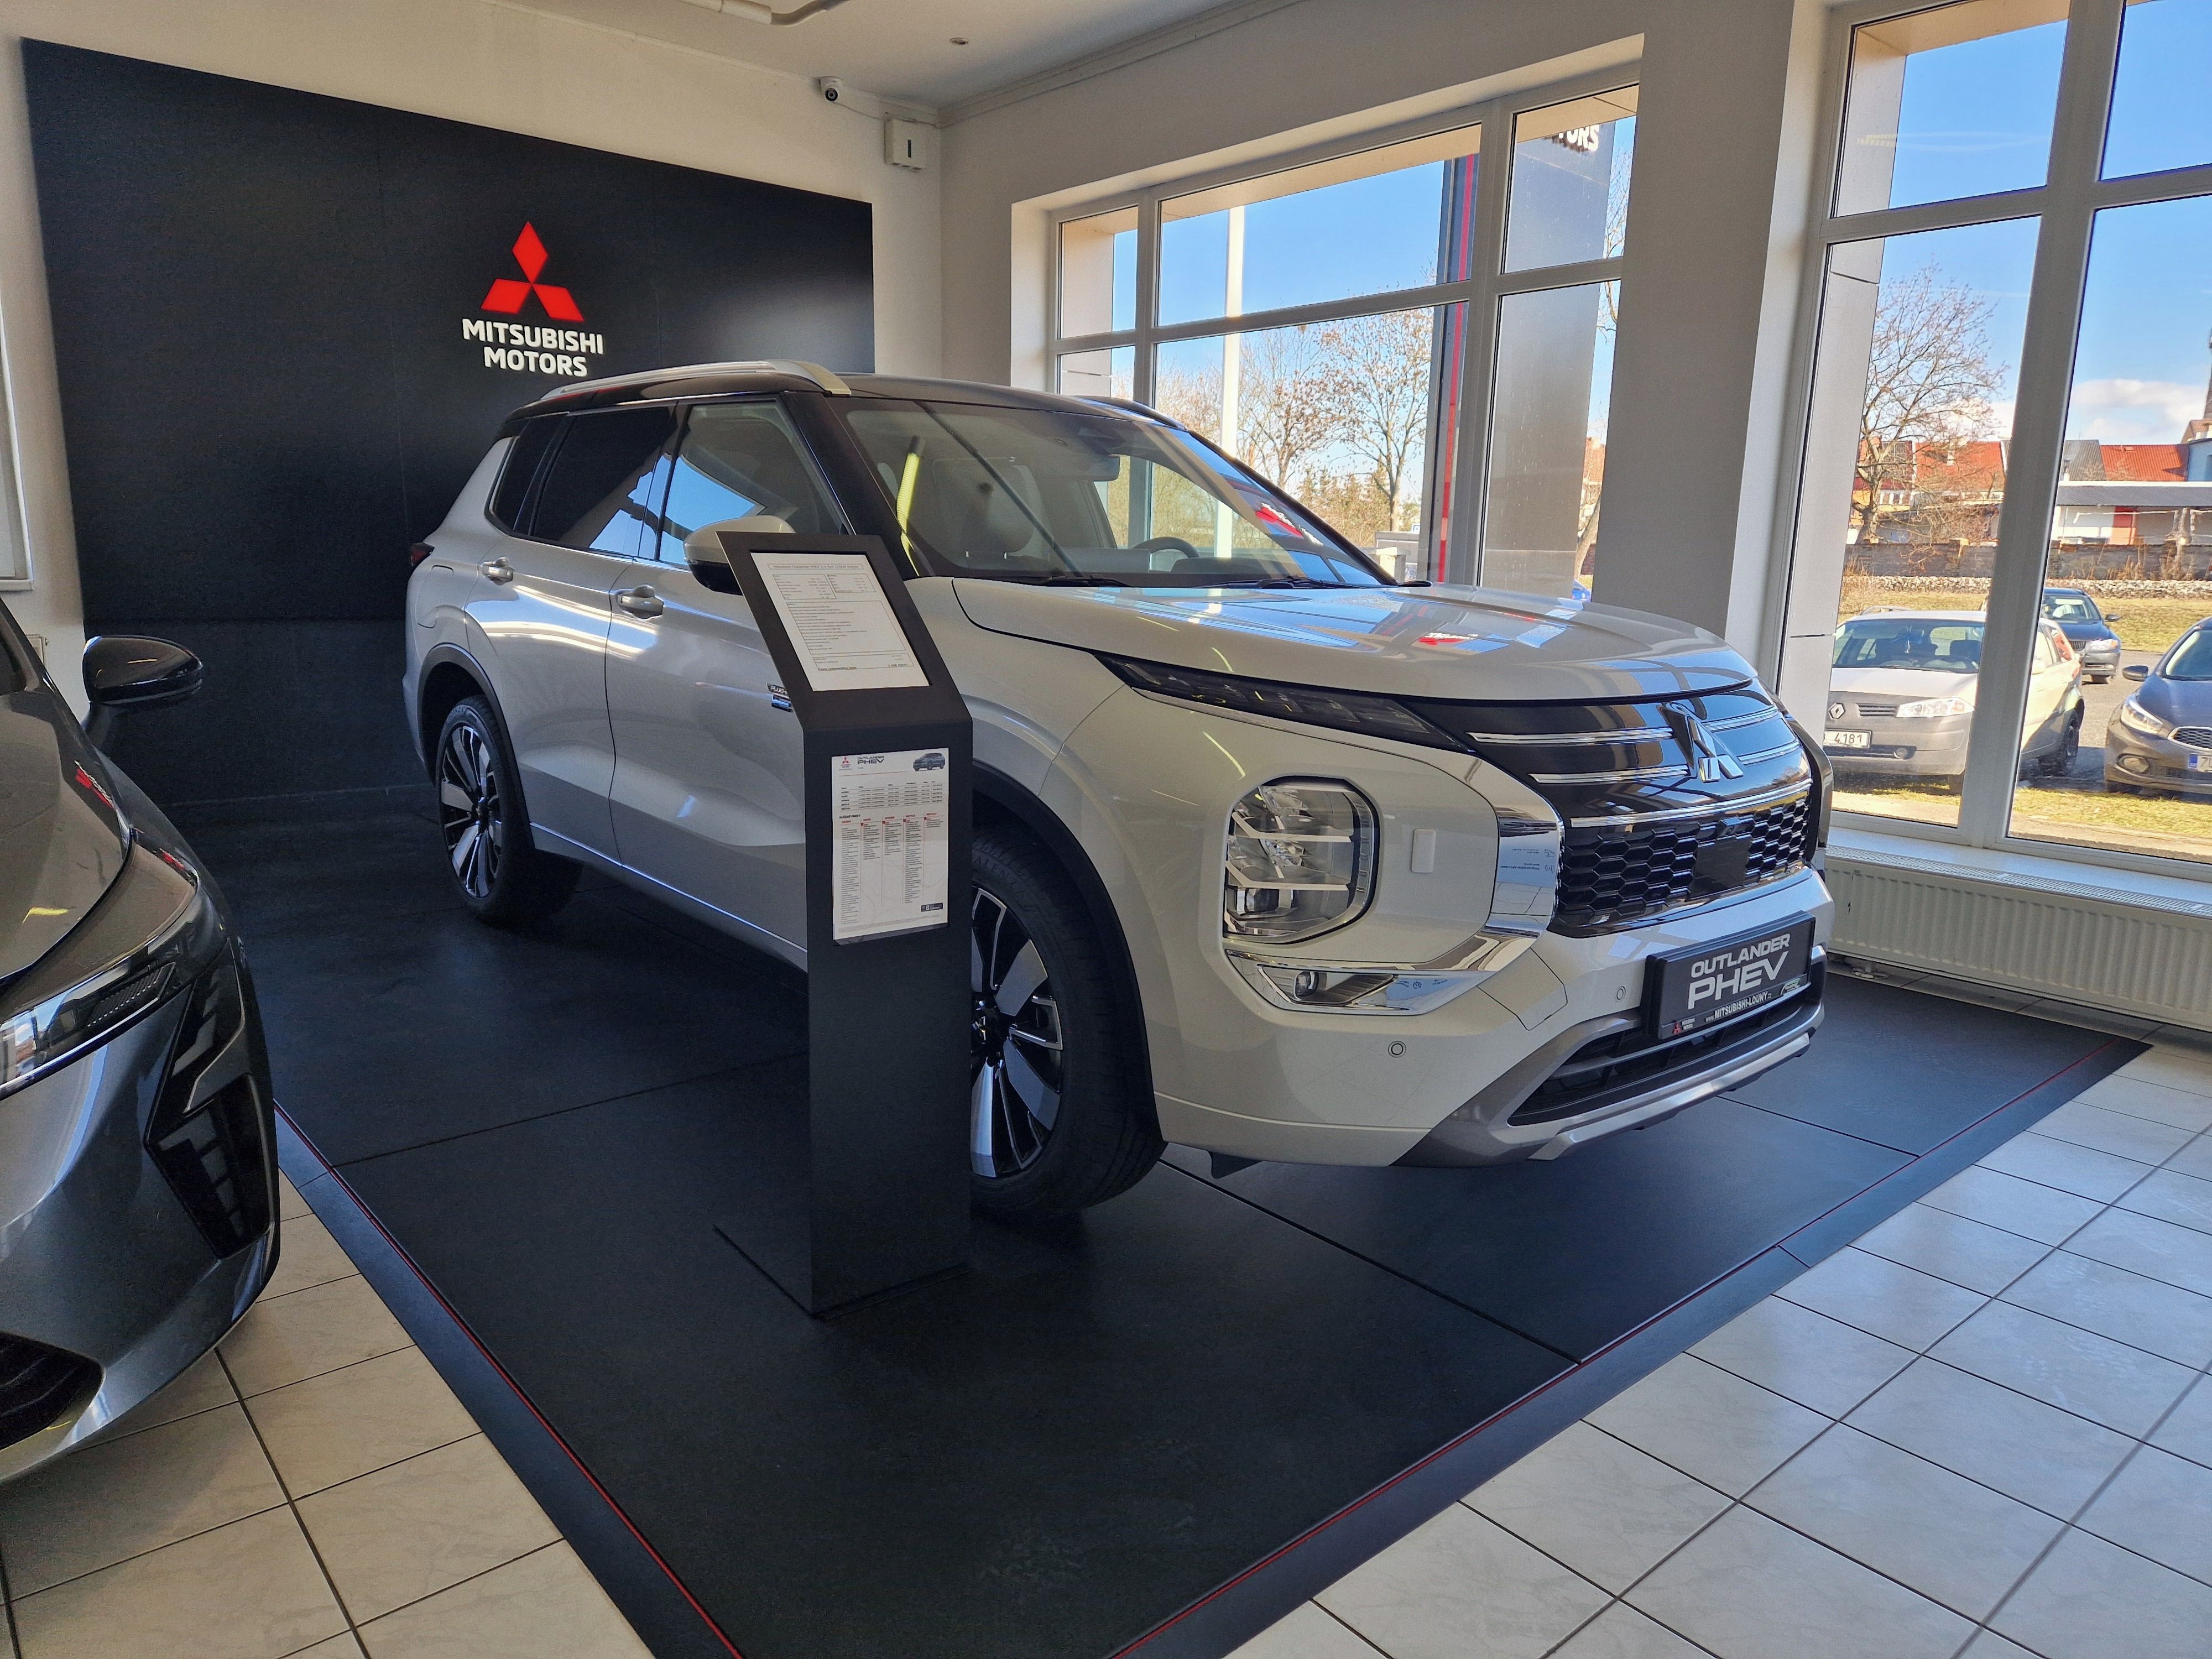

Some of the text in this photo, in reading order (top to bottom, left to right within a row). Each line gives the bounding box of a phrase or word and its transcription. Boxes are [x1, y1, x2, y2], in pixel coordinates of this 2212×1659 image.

[462, 318, 604, 354] MITSUBISHI
[483, 346, 588, 377] MOTORS
[1834, 733, 1863, 744] 4181
[1691, 933, 1791, 978] OUTLANDER
[1688, 951, 1789, 1010] PHEV
